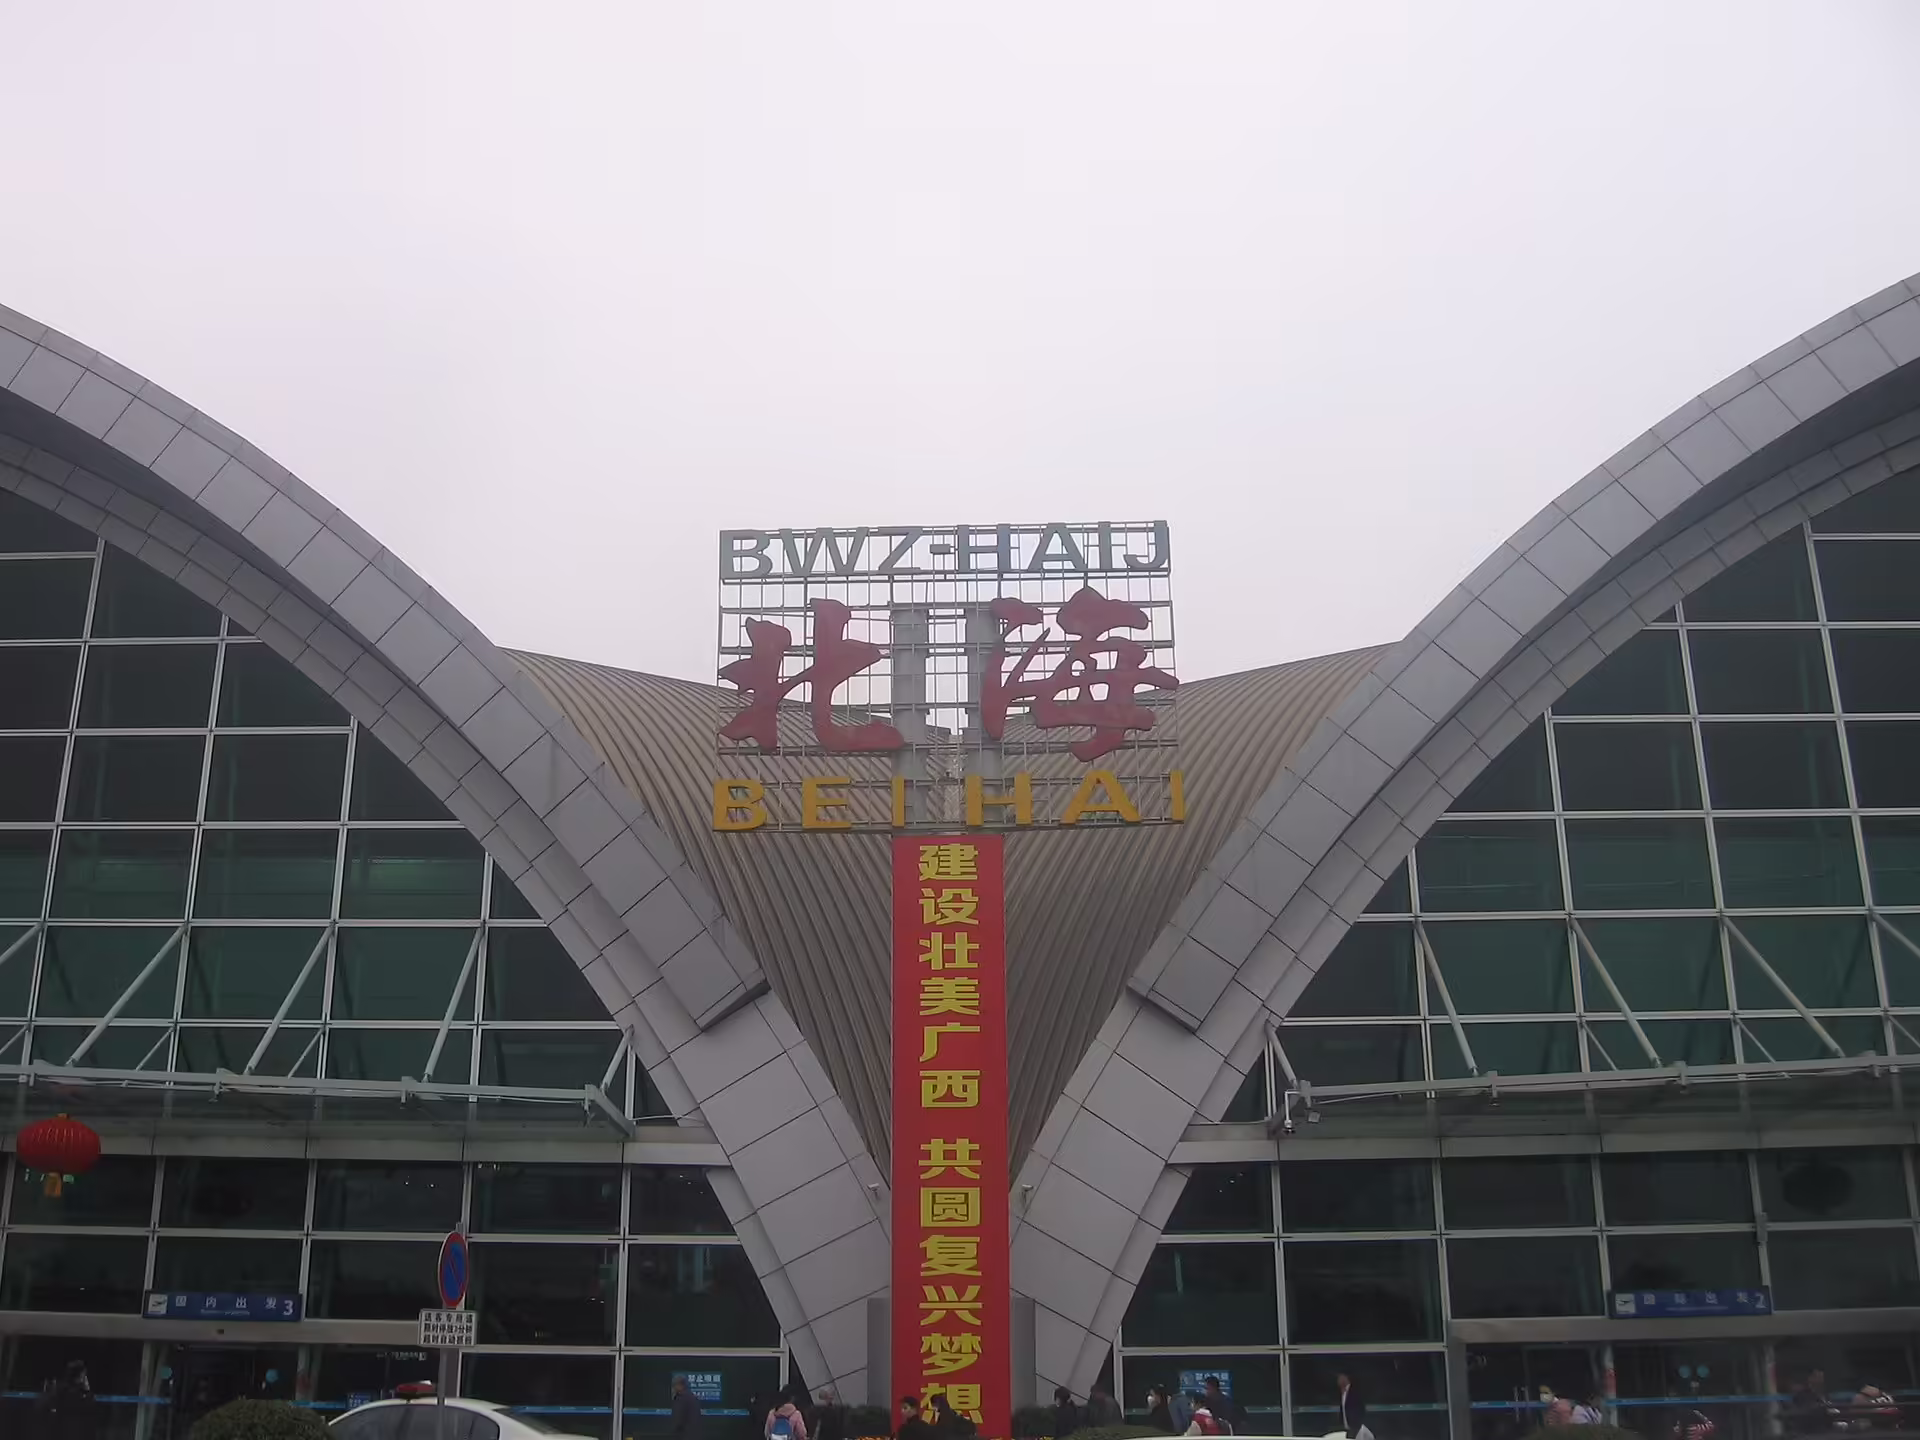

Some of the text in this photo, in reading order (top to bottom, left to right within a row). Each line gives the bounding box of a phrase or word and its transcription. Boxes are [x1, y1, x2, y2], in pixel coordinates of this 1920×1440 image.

[720, 521, 1168, 578] BWZ-HAIJ
[718, 585, 1180, 762] 北海
[713, 769, 1186, 831] BEIHAI
[918, 843, 983, 1425] 建设壮美广西 共圆复兴梦想
[175, 1295, 294, 1316] 国内出发 3
